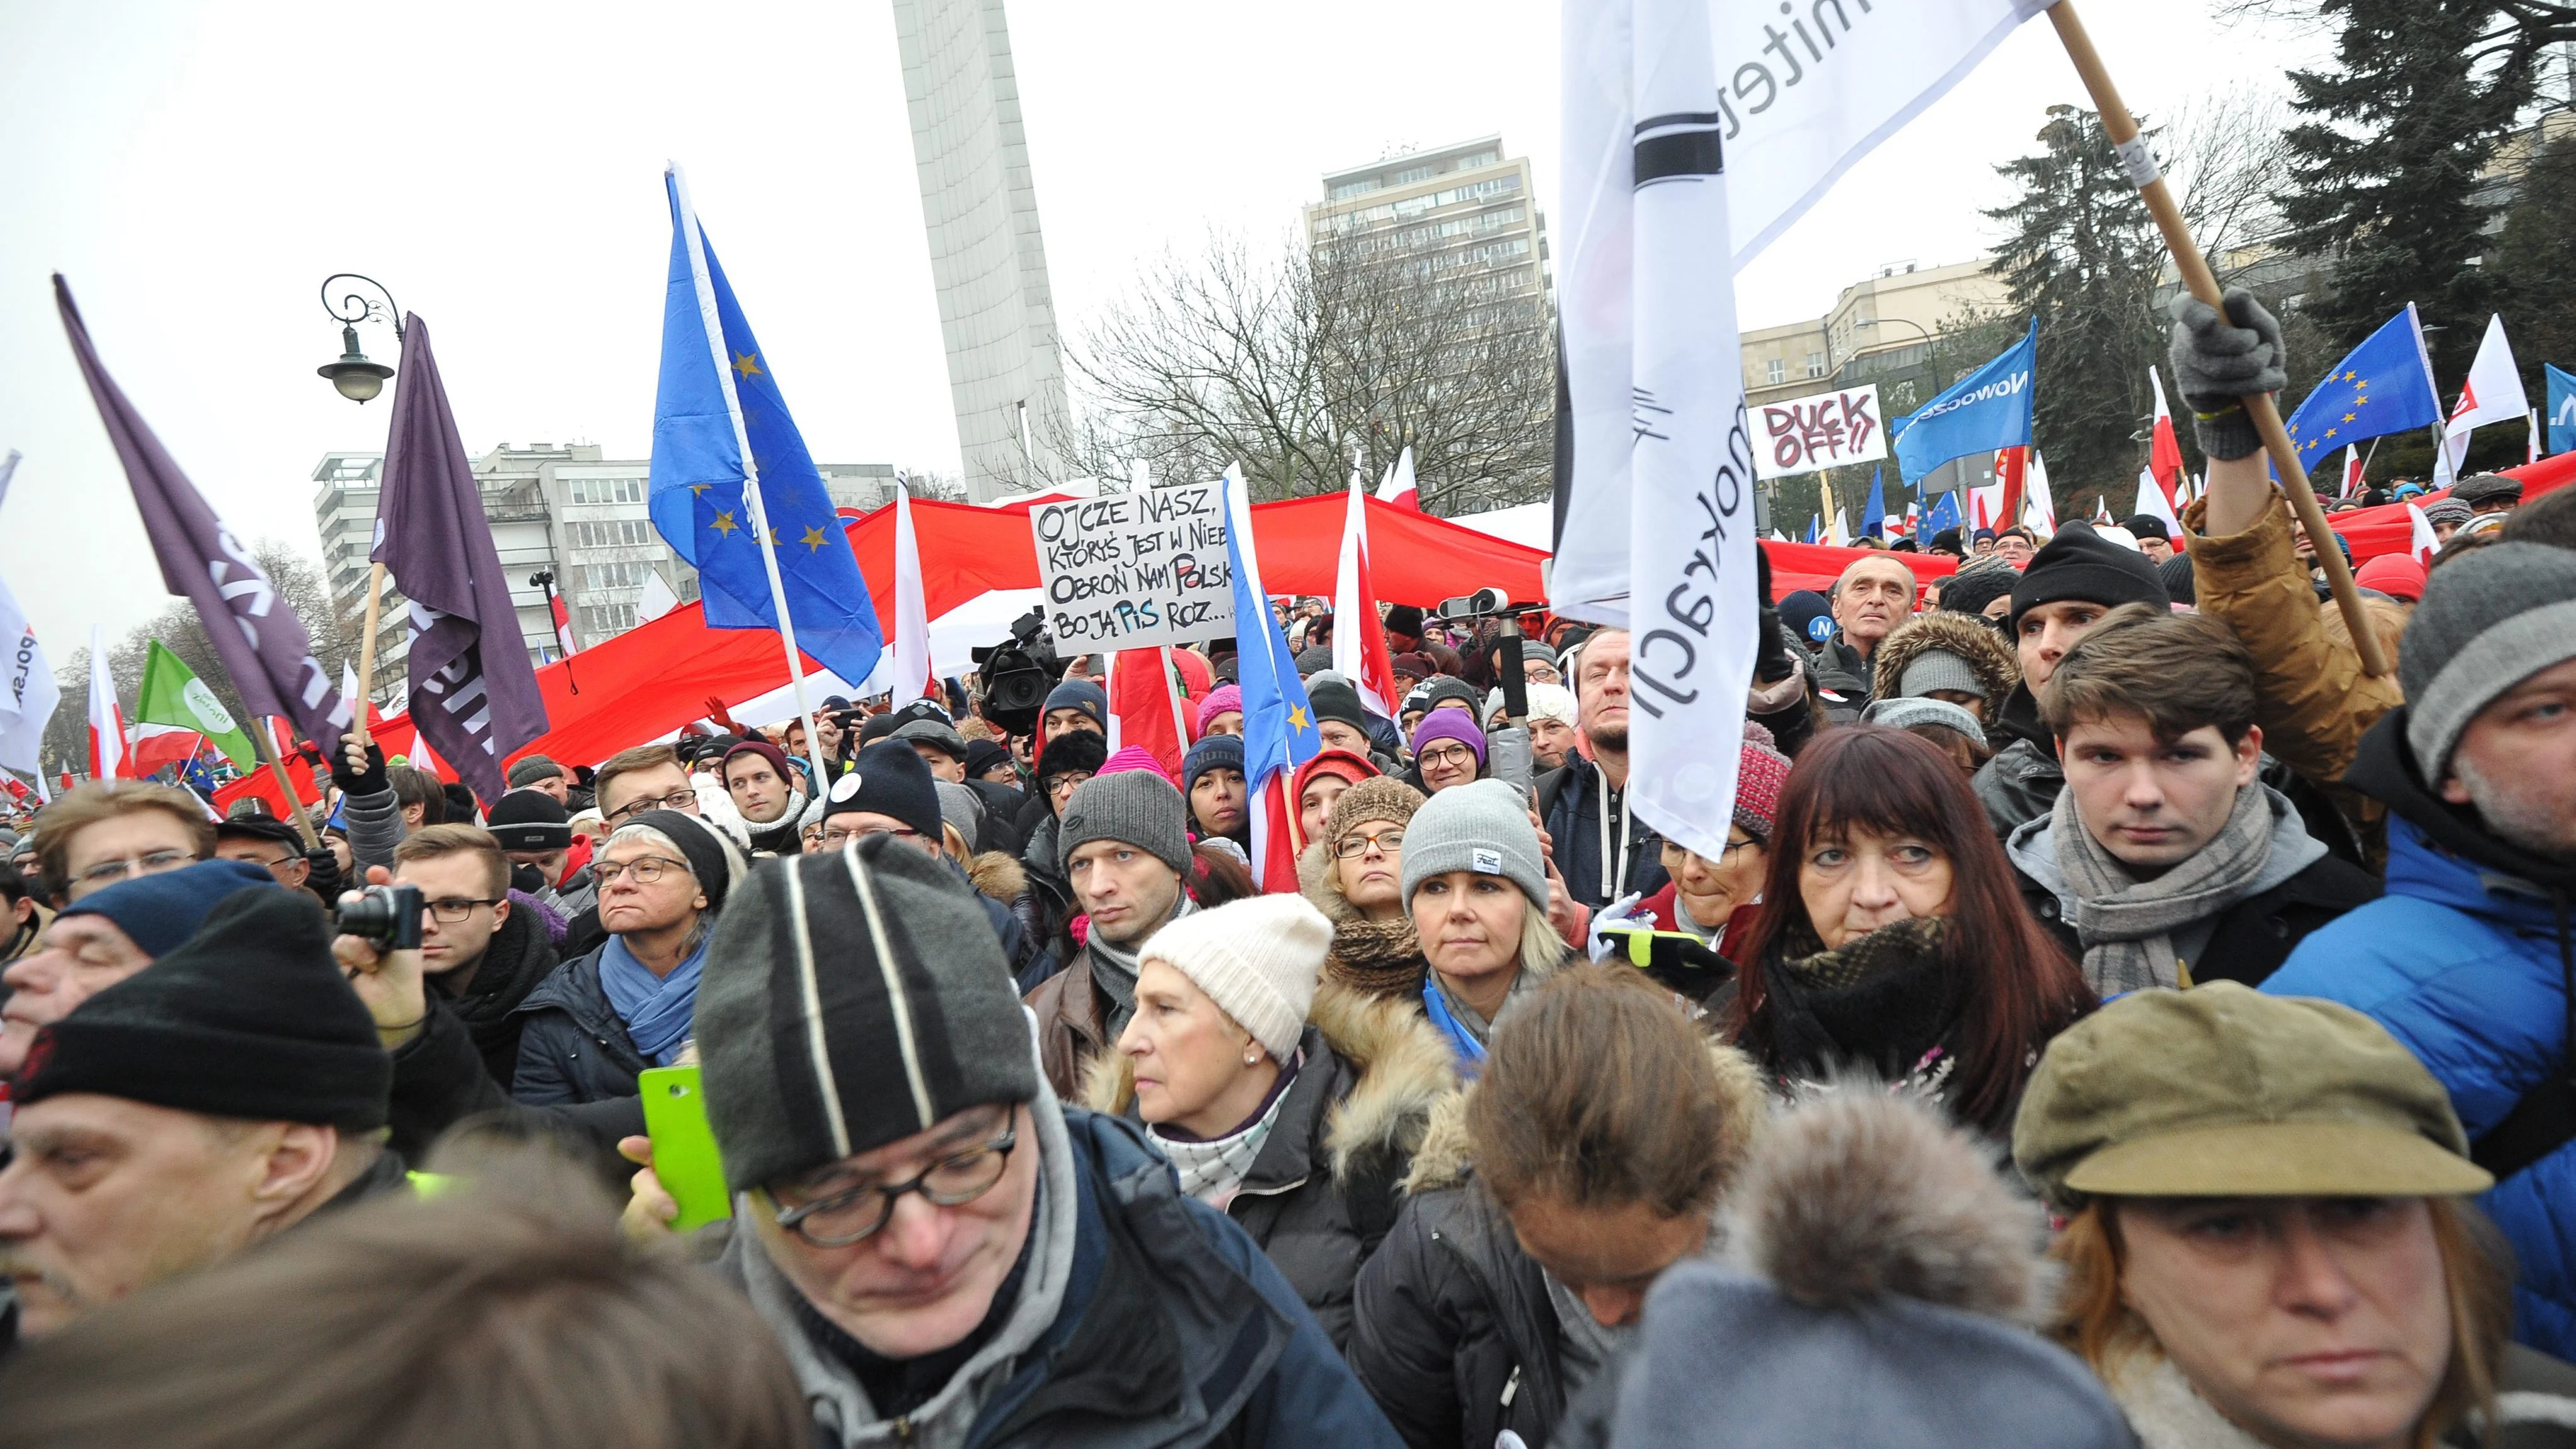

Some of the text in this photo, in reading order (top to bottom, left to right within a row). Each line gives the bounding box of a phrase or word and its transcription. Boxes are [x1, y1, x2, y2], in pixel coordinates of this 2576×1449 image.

[1763, 392, 1876, 436] DUCK
[1775, 421, 1872, 468] OFF!!
[1038, 488, 1216, 551] OJCZE NASZ,
[1047, 530, 1120, 573] KTÓRYŚ
[1121, 531, 1164, 568] JEST
[1170, 526, 1182, 550] W
[1050, 553, 1233, 604] OBROŃ NAM POLSK
[1811, 620, 1831, 636] .N
